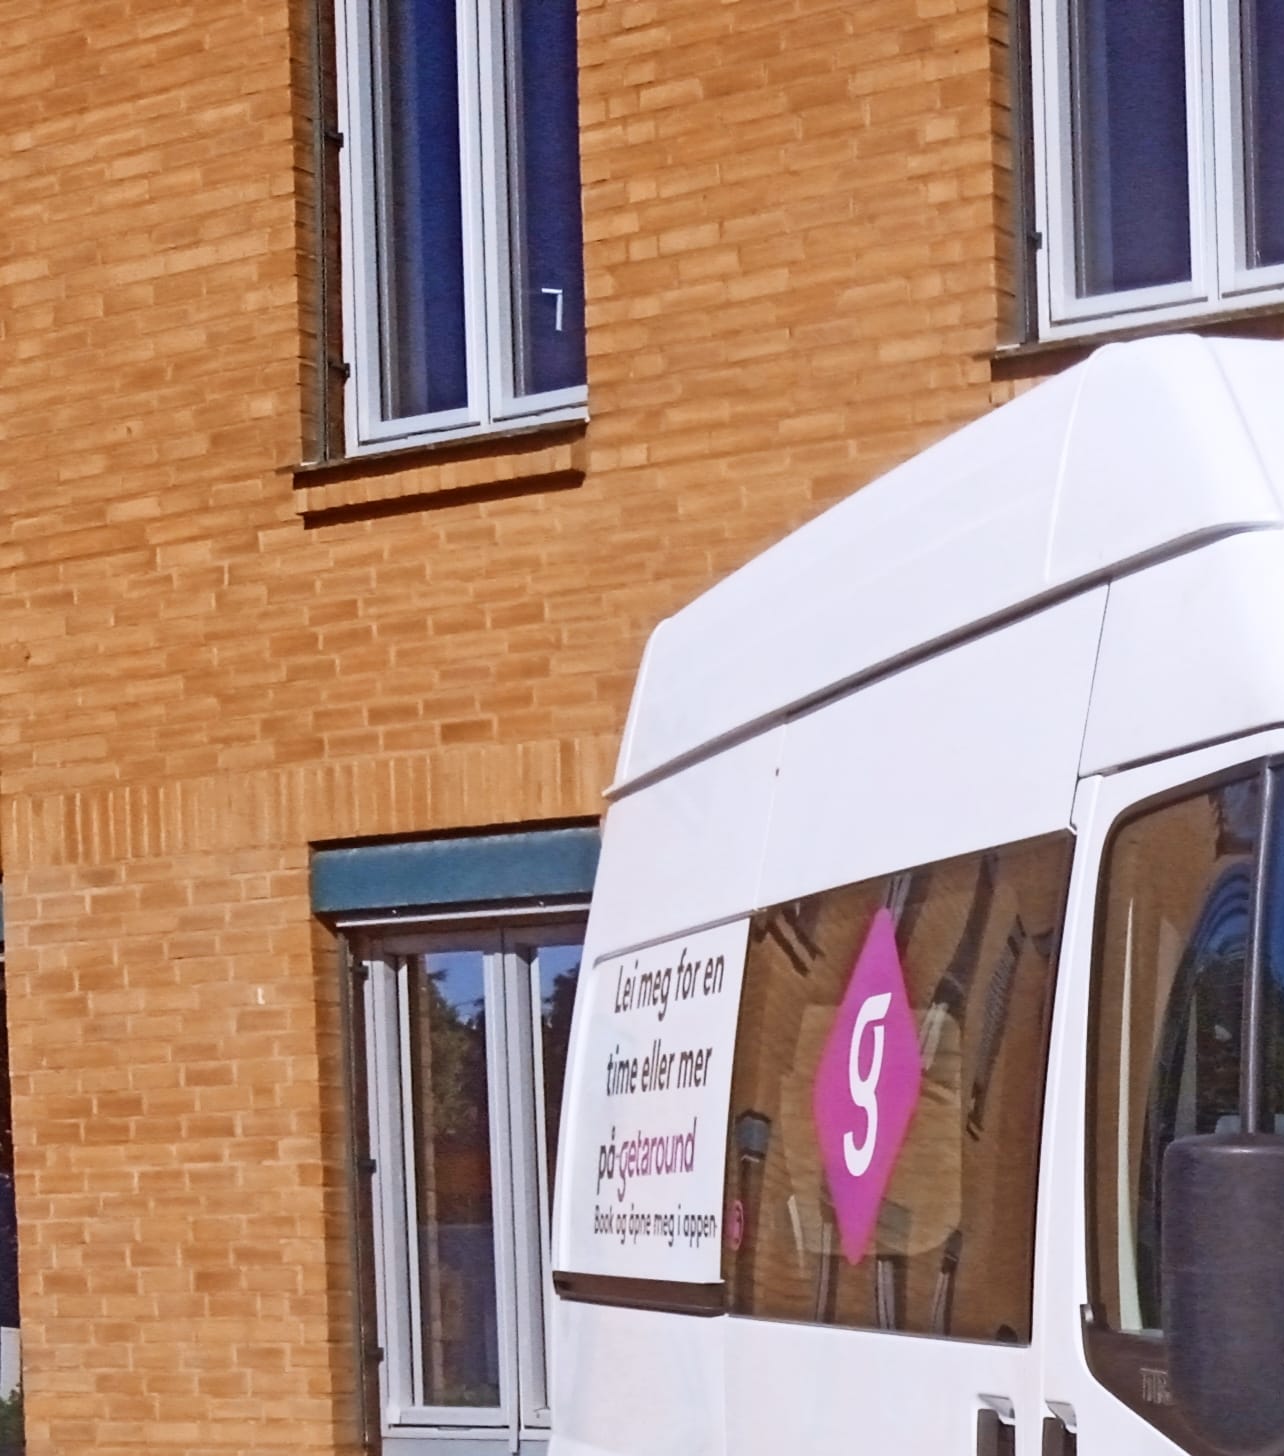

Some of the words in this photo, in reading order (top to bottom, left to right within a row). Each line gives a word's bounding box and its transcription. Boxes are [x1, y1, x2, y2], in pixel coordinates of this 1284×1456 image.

[614, 959, 639, 1014] Lei
[637, 967, 672, 1022] meg
[675, 947, 701, 1001] for
[703, 954, 725, 996] en
[606, 1043, 638, 1097] time
[641, 1038, 675, 1093] eller
[677, 1047, 713, 1090] mer
[596, 1125, 616, 1196] på
[617, 1116, 698, 1203] getaround
[616, 1213, 627, 1245] og
[653, 1213, 675, 1248] meg
